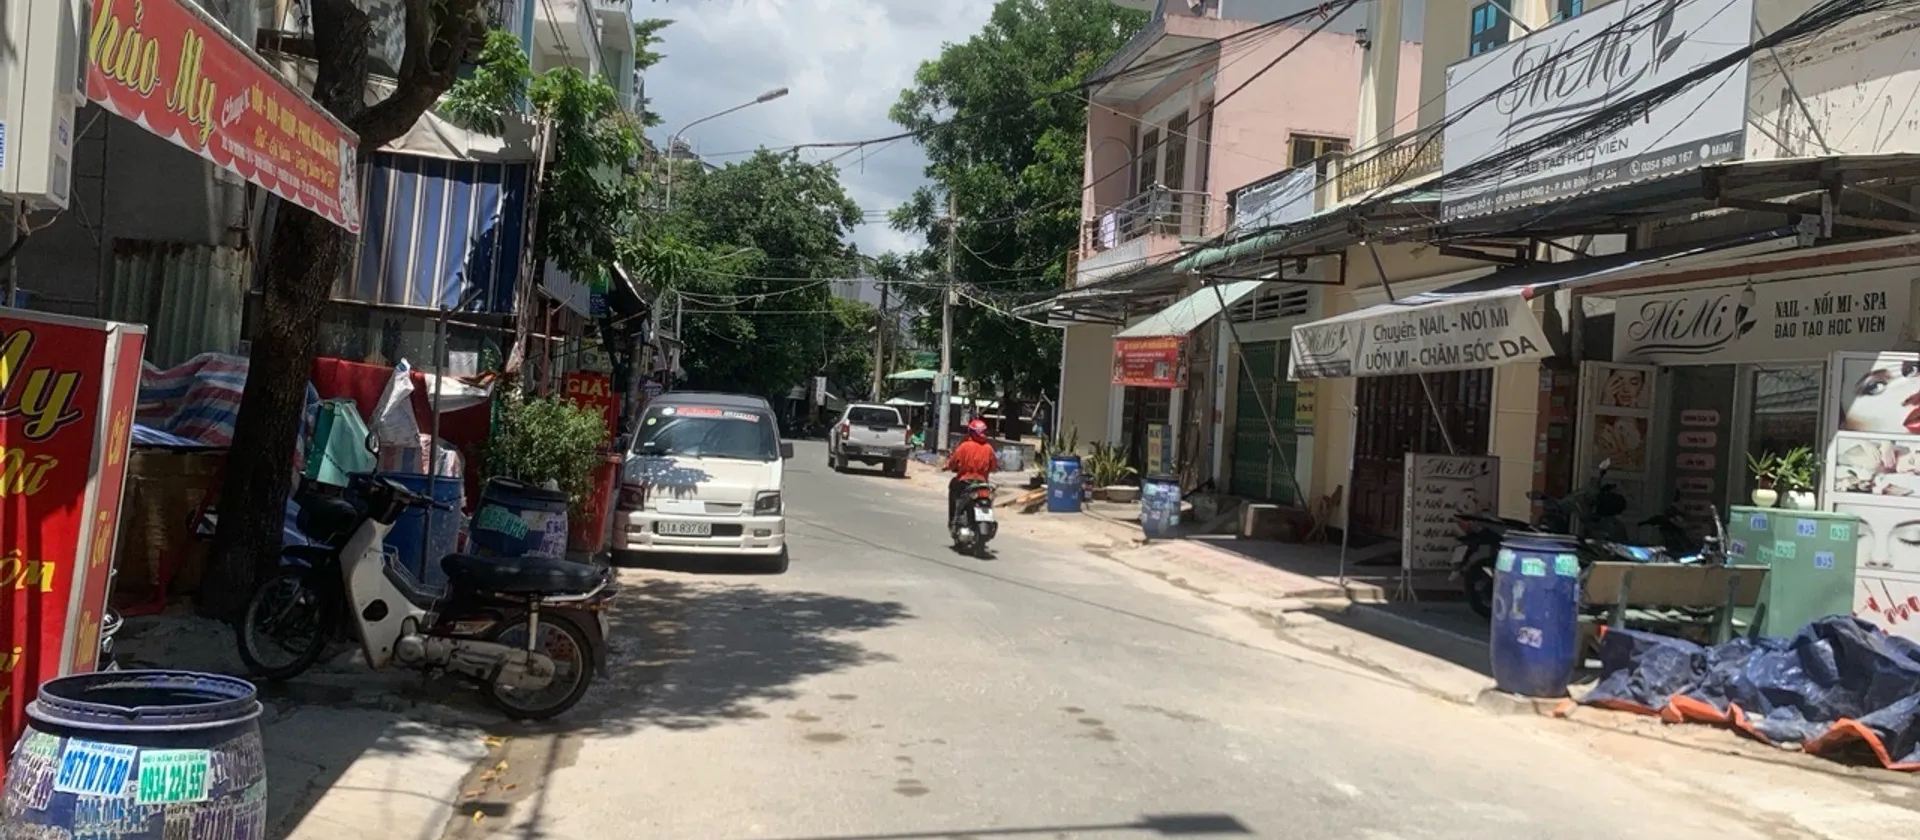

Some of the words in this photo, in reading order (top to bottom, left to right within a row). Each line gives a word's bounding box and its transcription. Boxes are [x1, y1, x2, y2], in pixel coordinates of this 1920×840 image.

[89, 0, 161, 98] hảo
[166, 28, 217, 147] My
[1597, 136, 1629, 157] VIÊN
[1420, 316, 1449, 336] NAIL
[1461, 303, 1488, 331] NỐI
[1490, 308, 1509, 328] MI
[1628, 293, 1735, 342] MiMi
[1775, 300, 1800, 320] NAIL
[1813, 291, 1834, 317] NỐI
[1837, 295, 1852, 314] MI
[1863, 291, 1888, 312] SPA
[1774, 321, 1797, 339] ĐÀO
[1802, 317, 1823, 340] TẠO
[1828, 317, 1853, 338] HỌC
[1858, 313, 1886, 333] VIÊN
[1366, 345, 1392, 370] UỐN
[1394, 350, 1409, 368] MI
[1420, 343, 1459, 366] CHĂM
[1463, 338, 1499, 363] SÓC
[1500, 336, 1539, 359] DA
